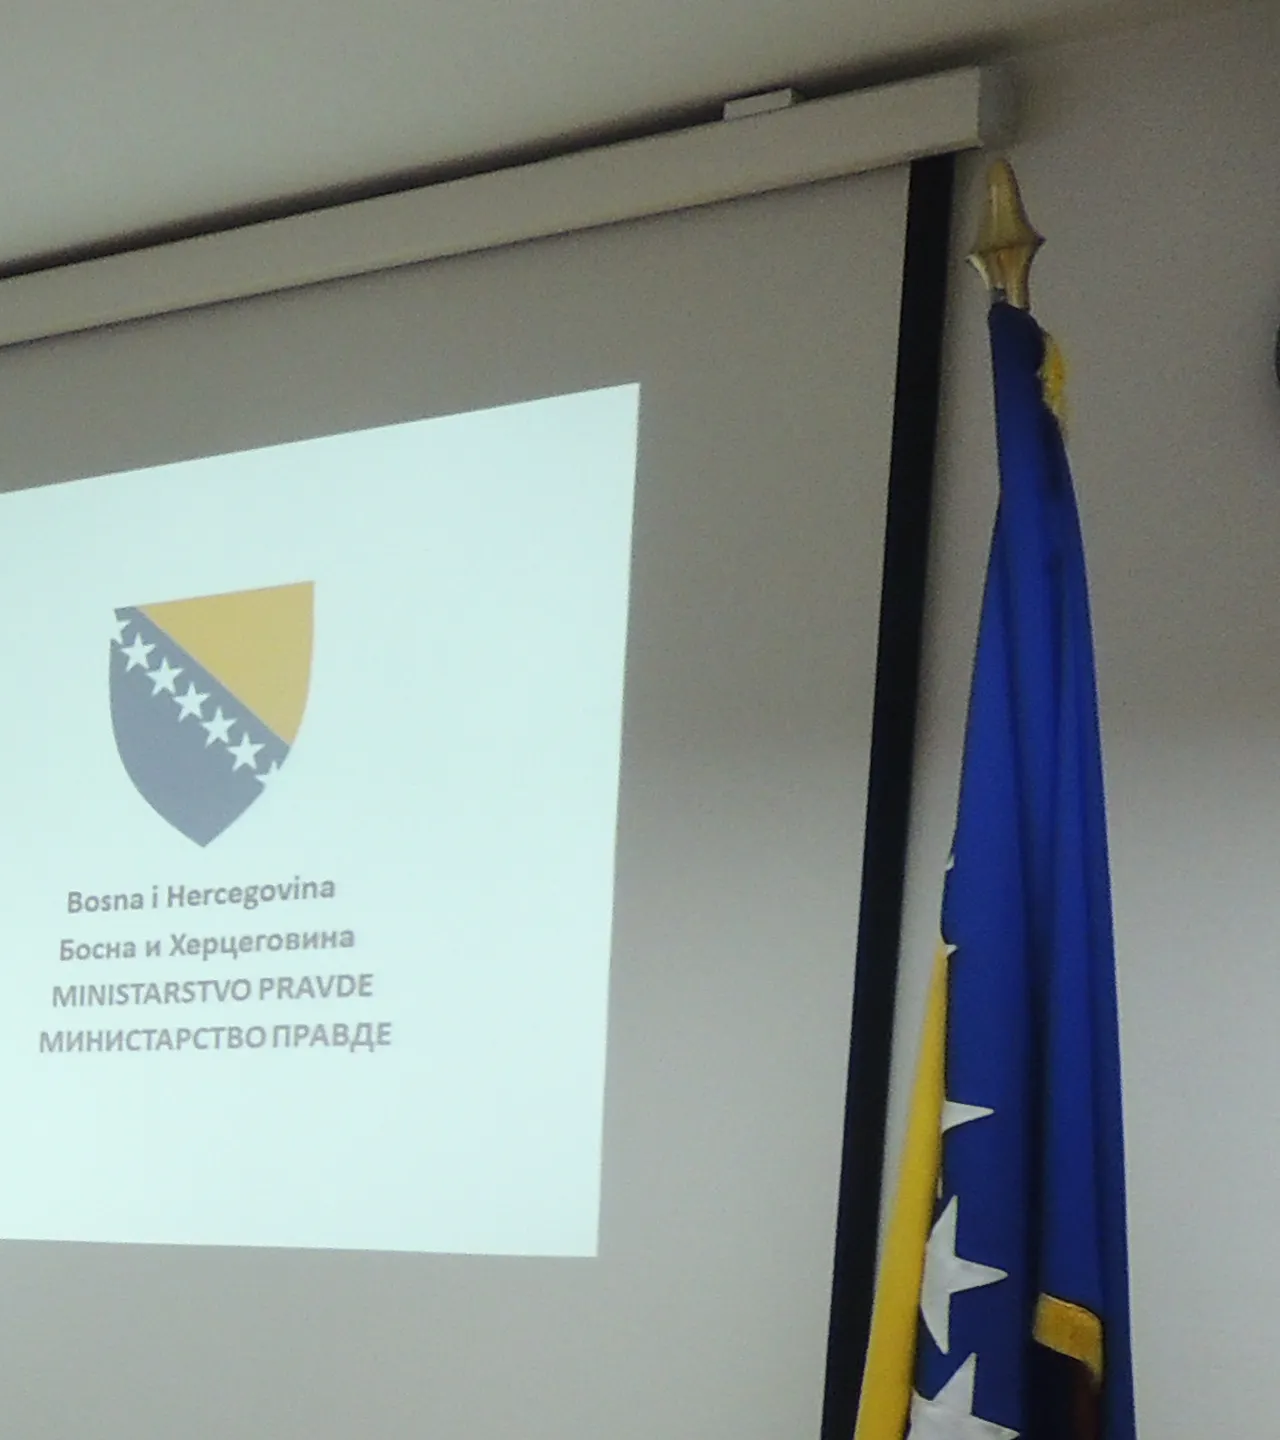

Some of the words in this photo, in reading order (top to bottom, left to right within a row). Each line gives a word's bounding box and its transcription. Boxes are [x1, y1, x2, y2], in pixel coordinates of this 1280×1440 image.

[67, 891, 144, 914] Bosna
[151, 886, 158, 909] i
[167, 875, 336, 911] Hercegovina
[59, 937, 137, 962] Босна
[145, 940, 161, 958] и
[169, 929, 356, 962] Херцеговина
[52, 977, 253, 1009] MINISTARSTVO
[258, 973, 374, 1002] PRAVDE
[39, 1024, 267, 1054] МИНИСТАРСТВО
[272, 1021, 392, 1053] ПРАВДЕ
